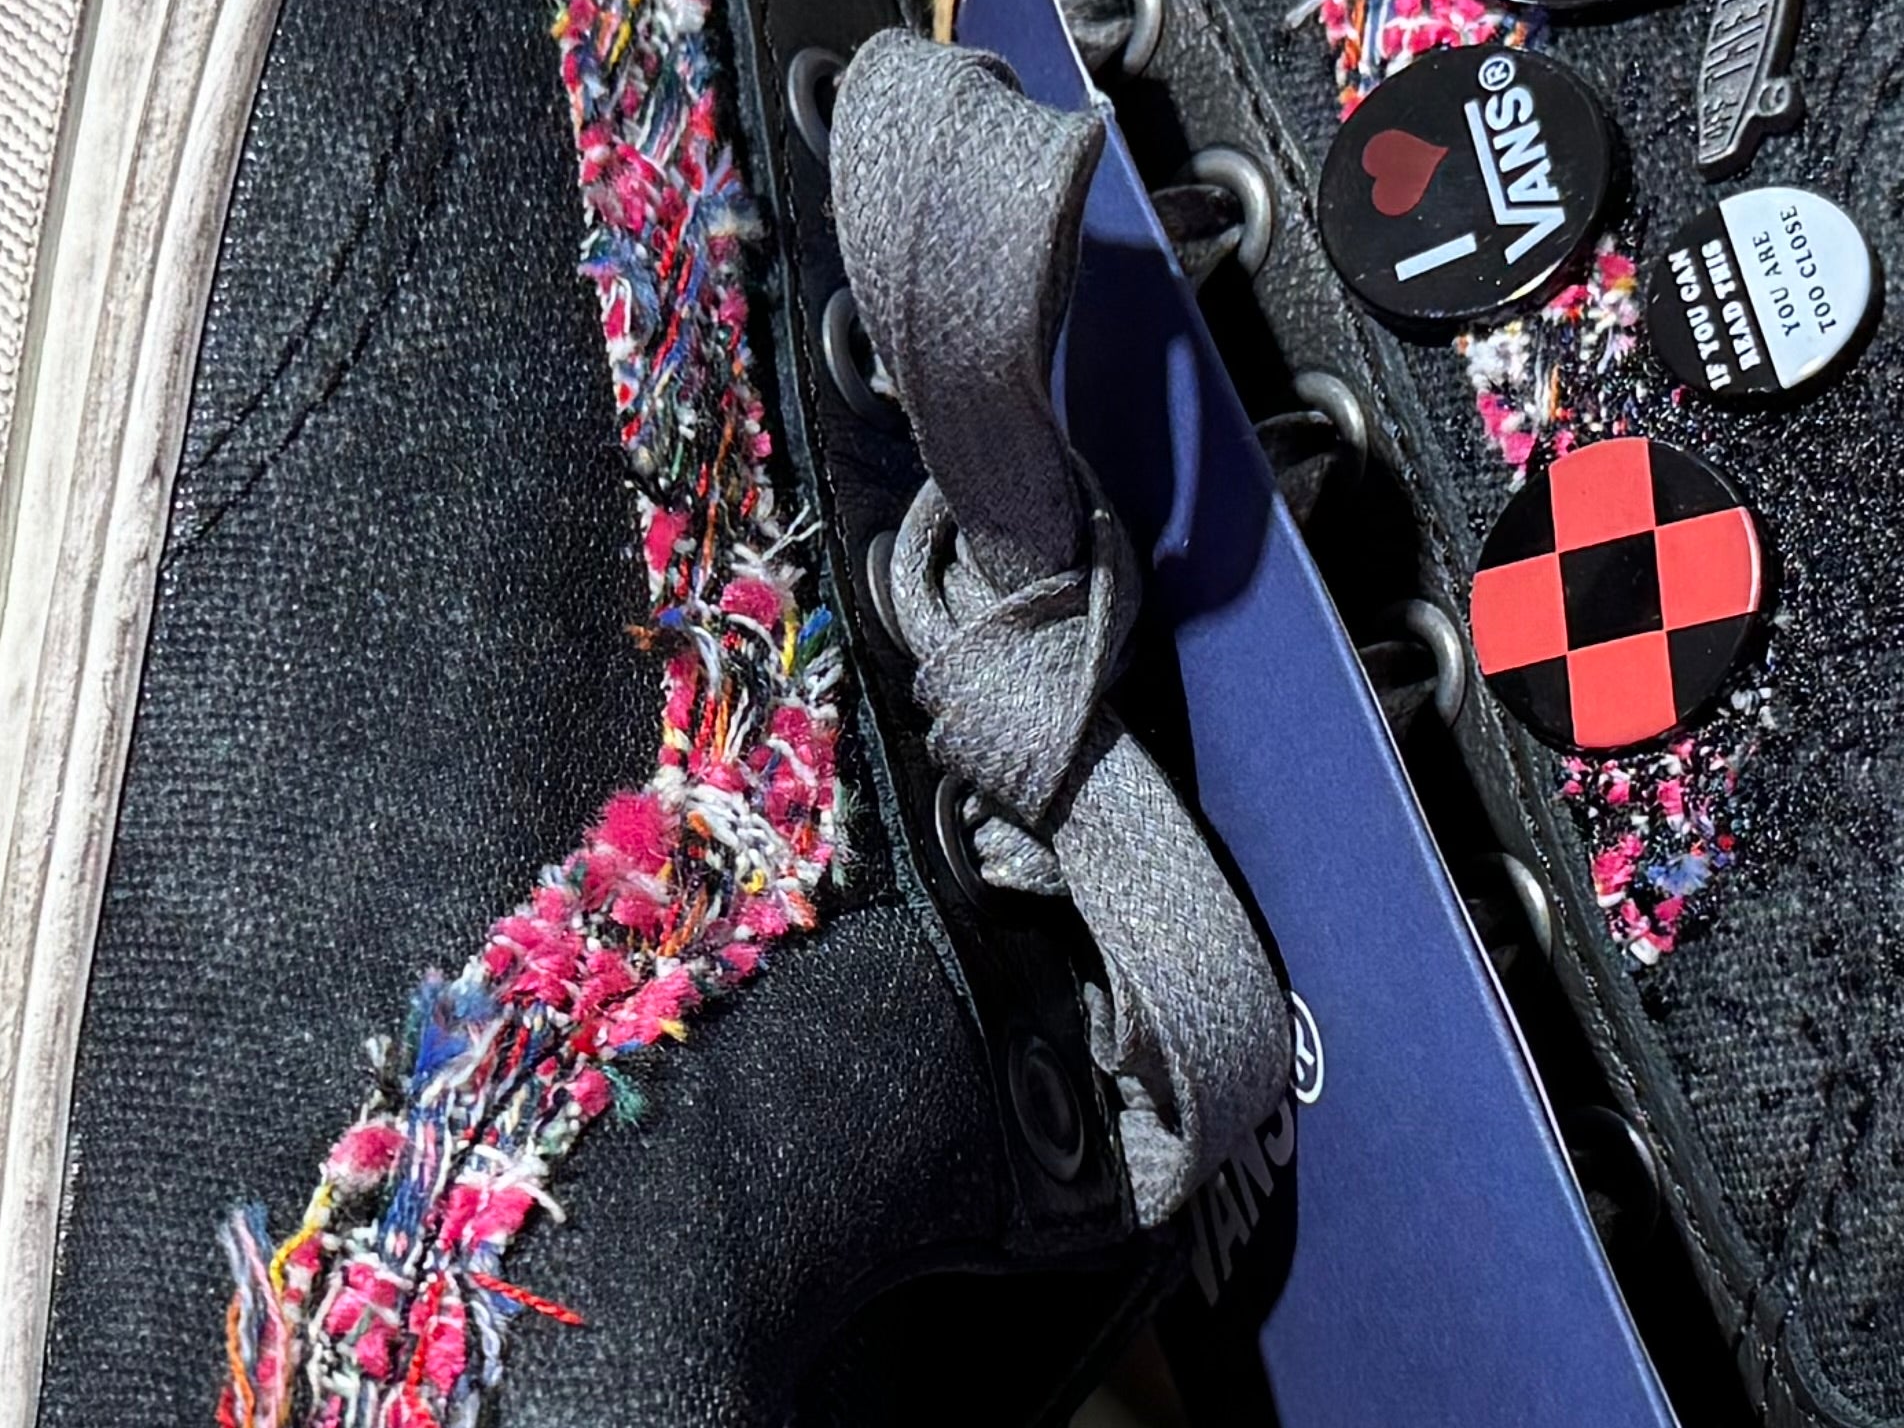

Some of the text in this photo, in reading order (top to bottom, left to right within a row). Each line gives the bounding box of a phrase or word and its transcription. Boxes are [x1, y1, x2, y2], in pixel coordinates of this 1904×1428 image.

[1703, 2, 1768, 95] THE
[1668, 248, 1732, 391] IF YOU CAN
[1701, 238, 1761, 371] READ THIS
[1752, 230, 1801, 337] YOU ARE
[1780, 205, 1837, 334] TOO CLOSE
